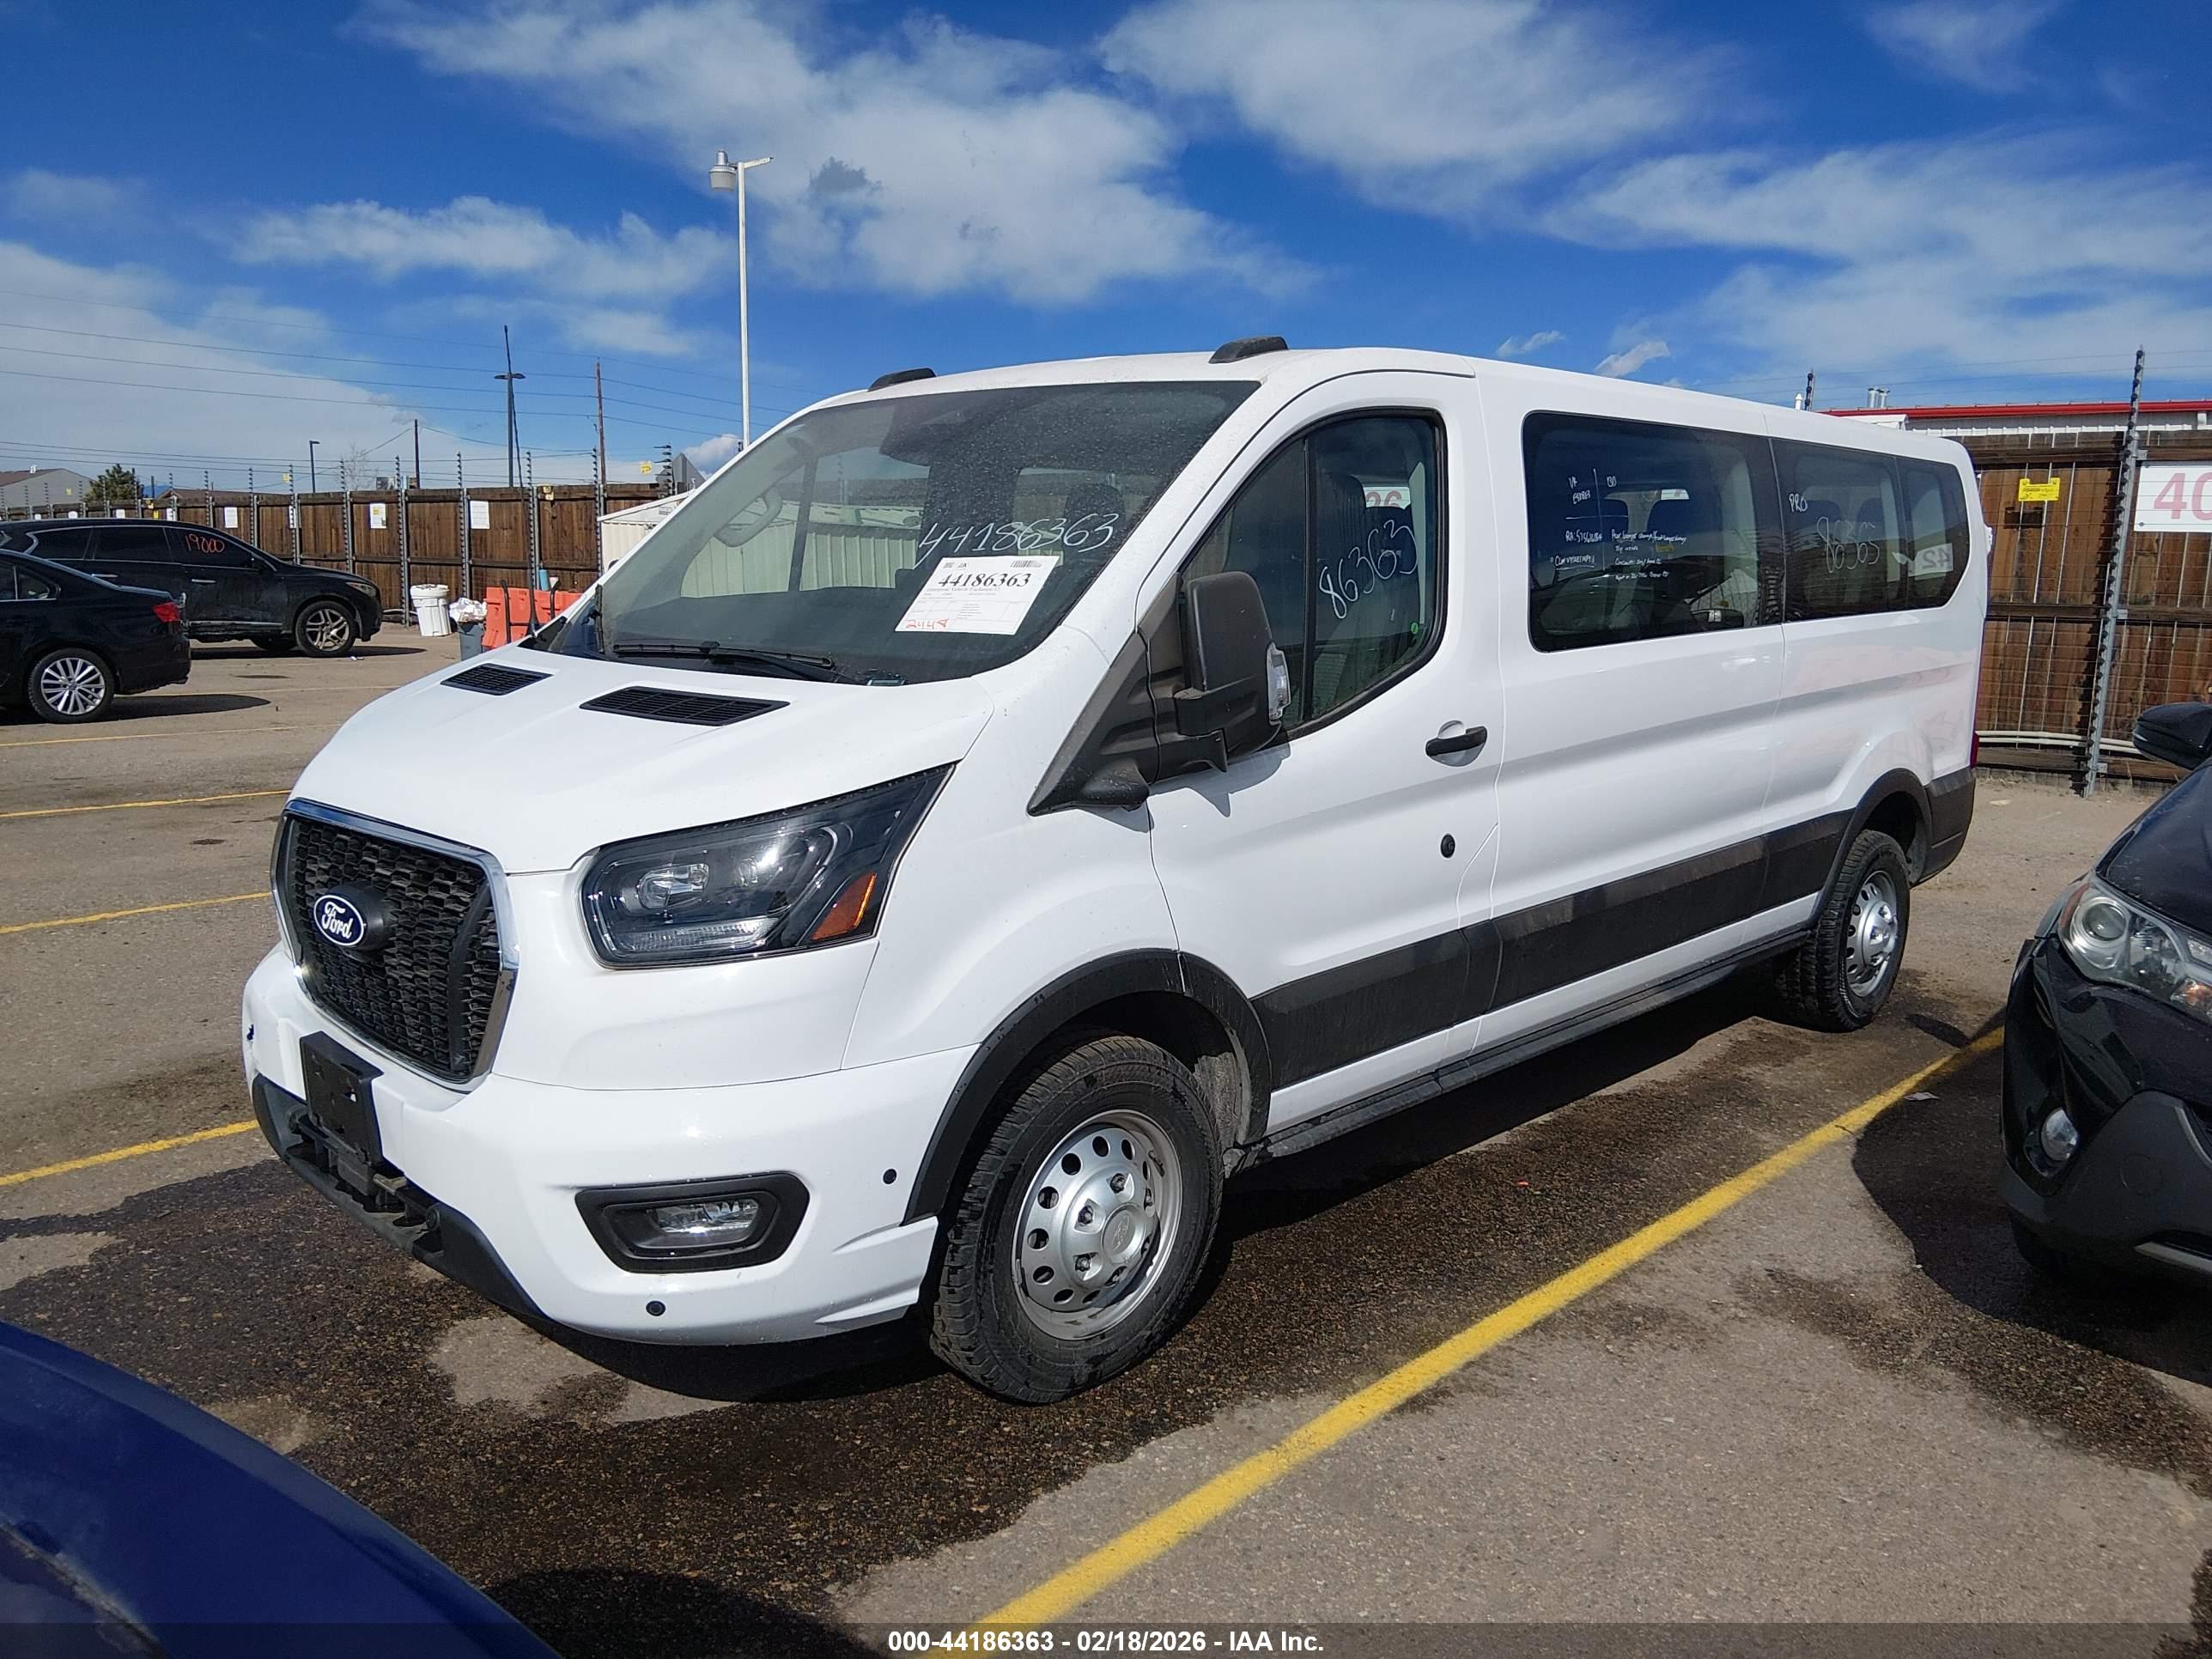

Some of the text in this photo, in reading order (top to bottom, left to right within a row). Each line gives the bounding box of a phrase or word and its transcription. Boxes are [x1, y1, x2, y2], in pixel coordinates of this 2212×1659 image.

[1789, 493, 1808, 513] PRO
[913, 514, 1119, 569] 44186363
[938, 573, 1031, 587] 44186363
[1319, 520, 1418, 619] 86363
[321, 902, 354, 939] Ford
